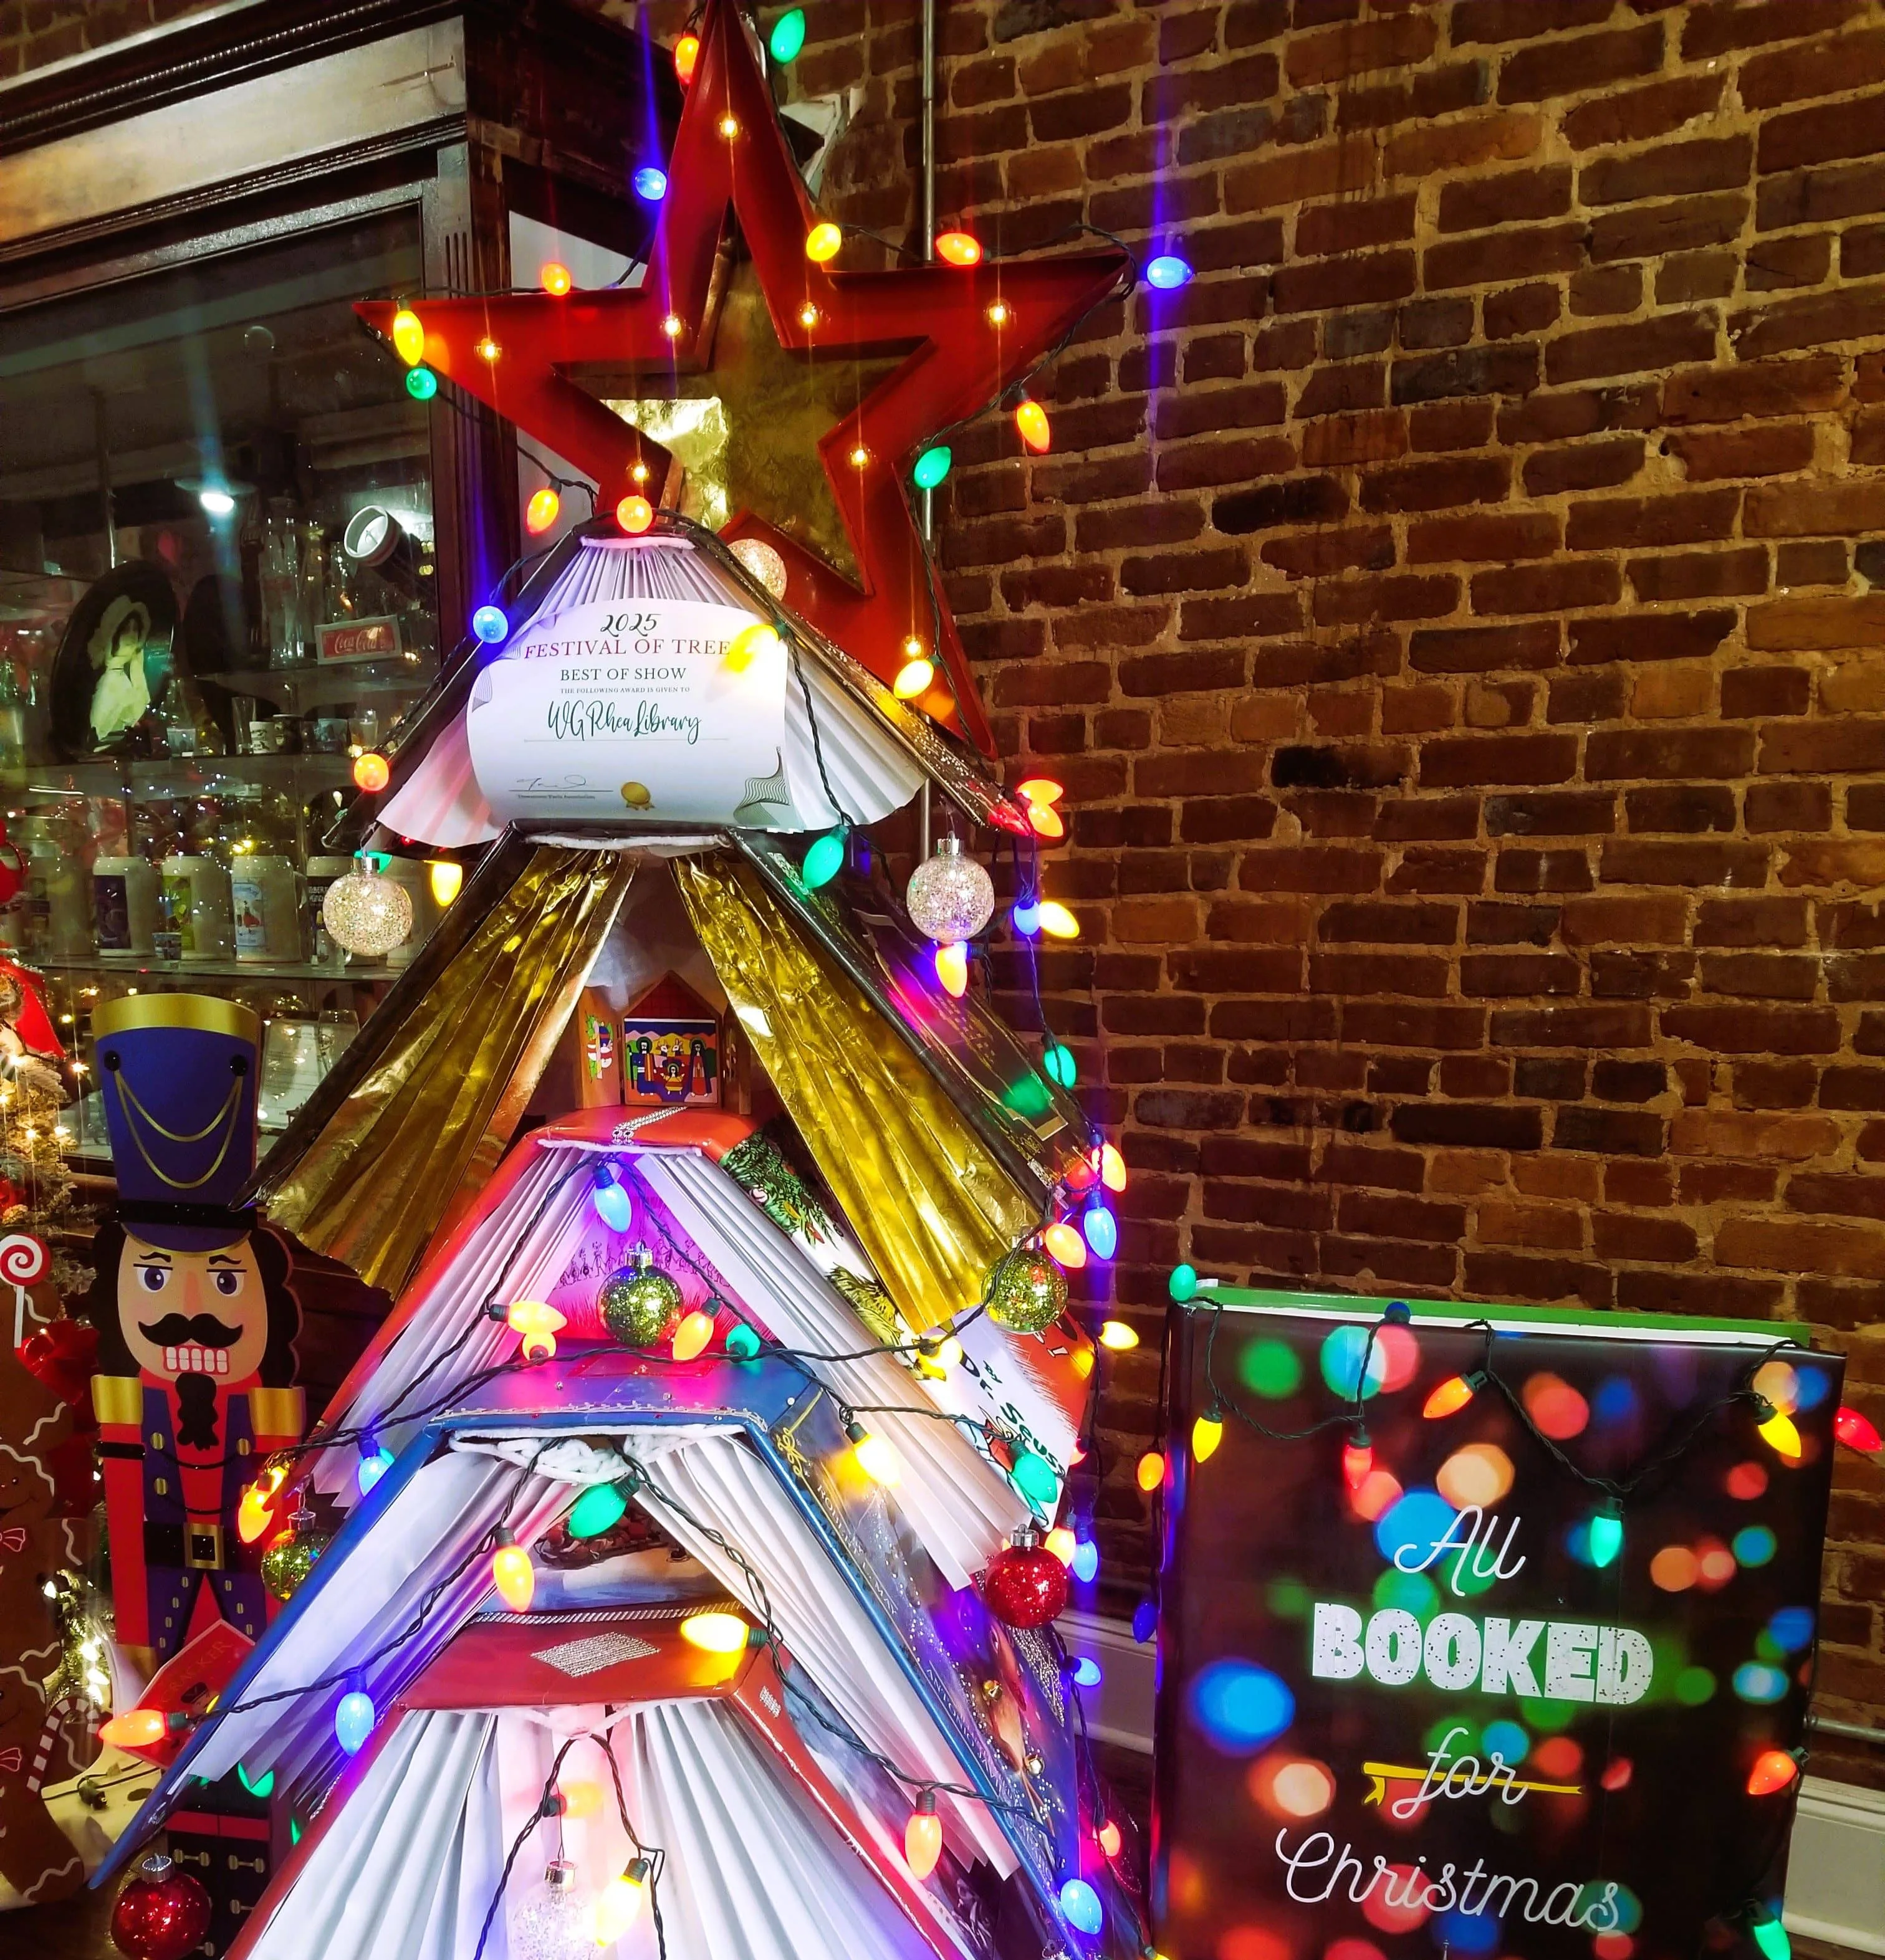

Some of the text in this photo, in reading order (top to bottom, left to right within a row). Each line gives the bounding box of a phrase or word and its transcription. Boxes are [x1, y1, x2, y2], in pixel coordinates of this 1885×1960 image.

[524, 638, 731, 659] FESTIVAL OF TREE
[600, 613, 661, 638] 2025
[560, 667, 687, 681] BEST OF SHOW
[548, 700, 702, 745] WG Rhea Library
[959, 1350, 1066, 1480] Dr. Seuss
[1394, 1504, 1527, 1597] All
[875, 1580, 898, 1615] MAY
[1312, 1602, 1654, 1705] BOOKED
[1391, 1727, 1529, 1819] for
[1275, 1827, 1620, 1932] Christmas
